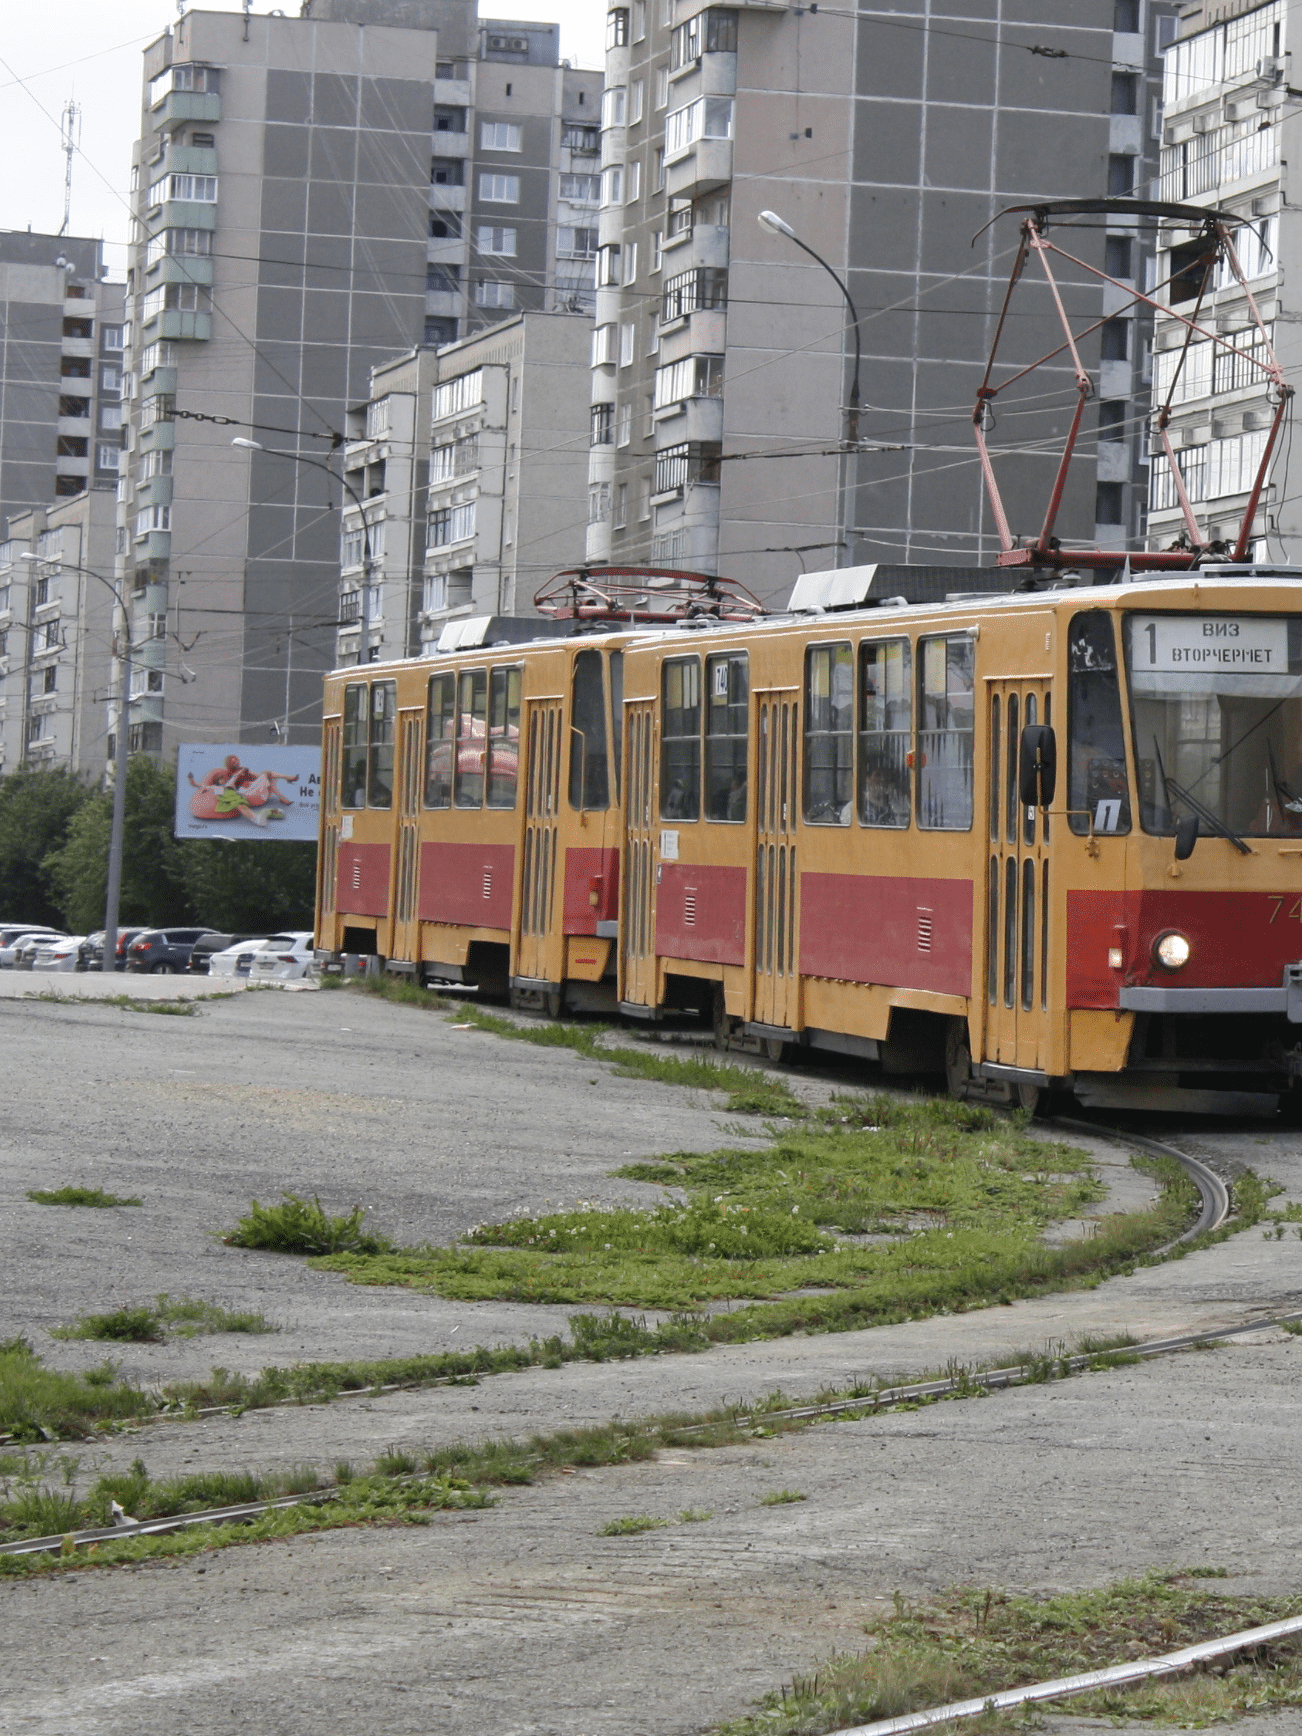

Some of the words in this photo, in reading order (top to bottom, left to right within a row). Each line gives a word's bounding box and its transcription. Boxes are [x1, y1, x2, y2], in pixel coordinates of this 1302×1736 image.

[1202, 623, 1240, 637] ВИЗ
[1144, 623, 1156, 664] 1
[1172, 648, 1272, 662] ВТОРЧЕРМЕТ
